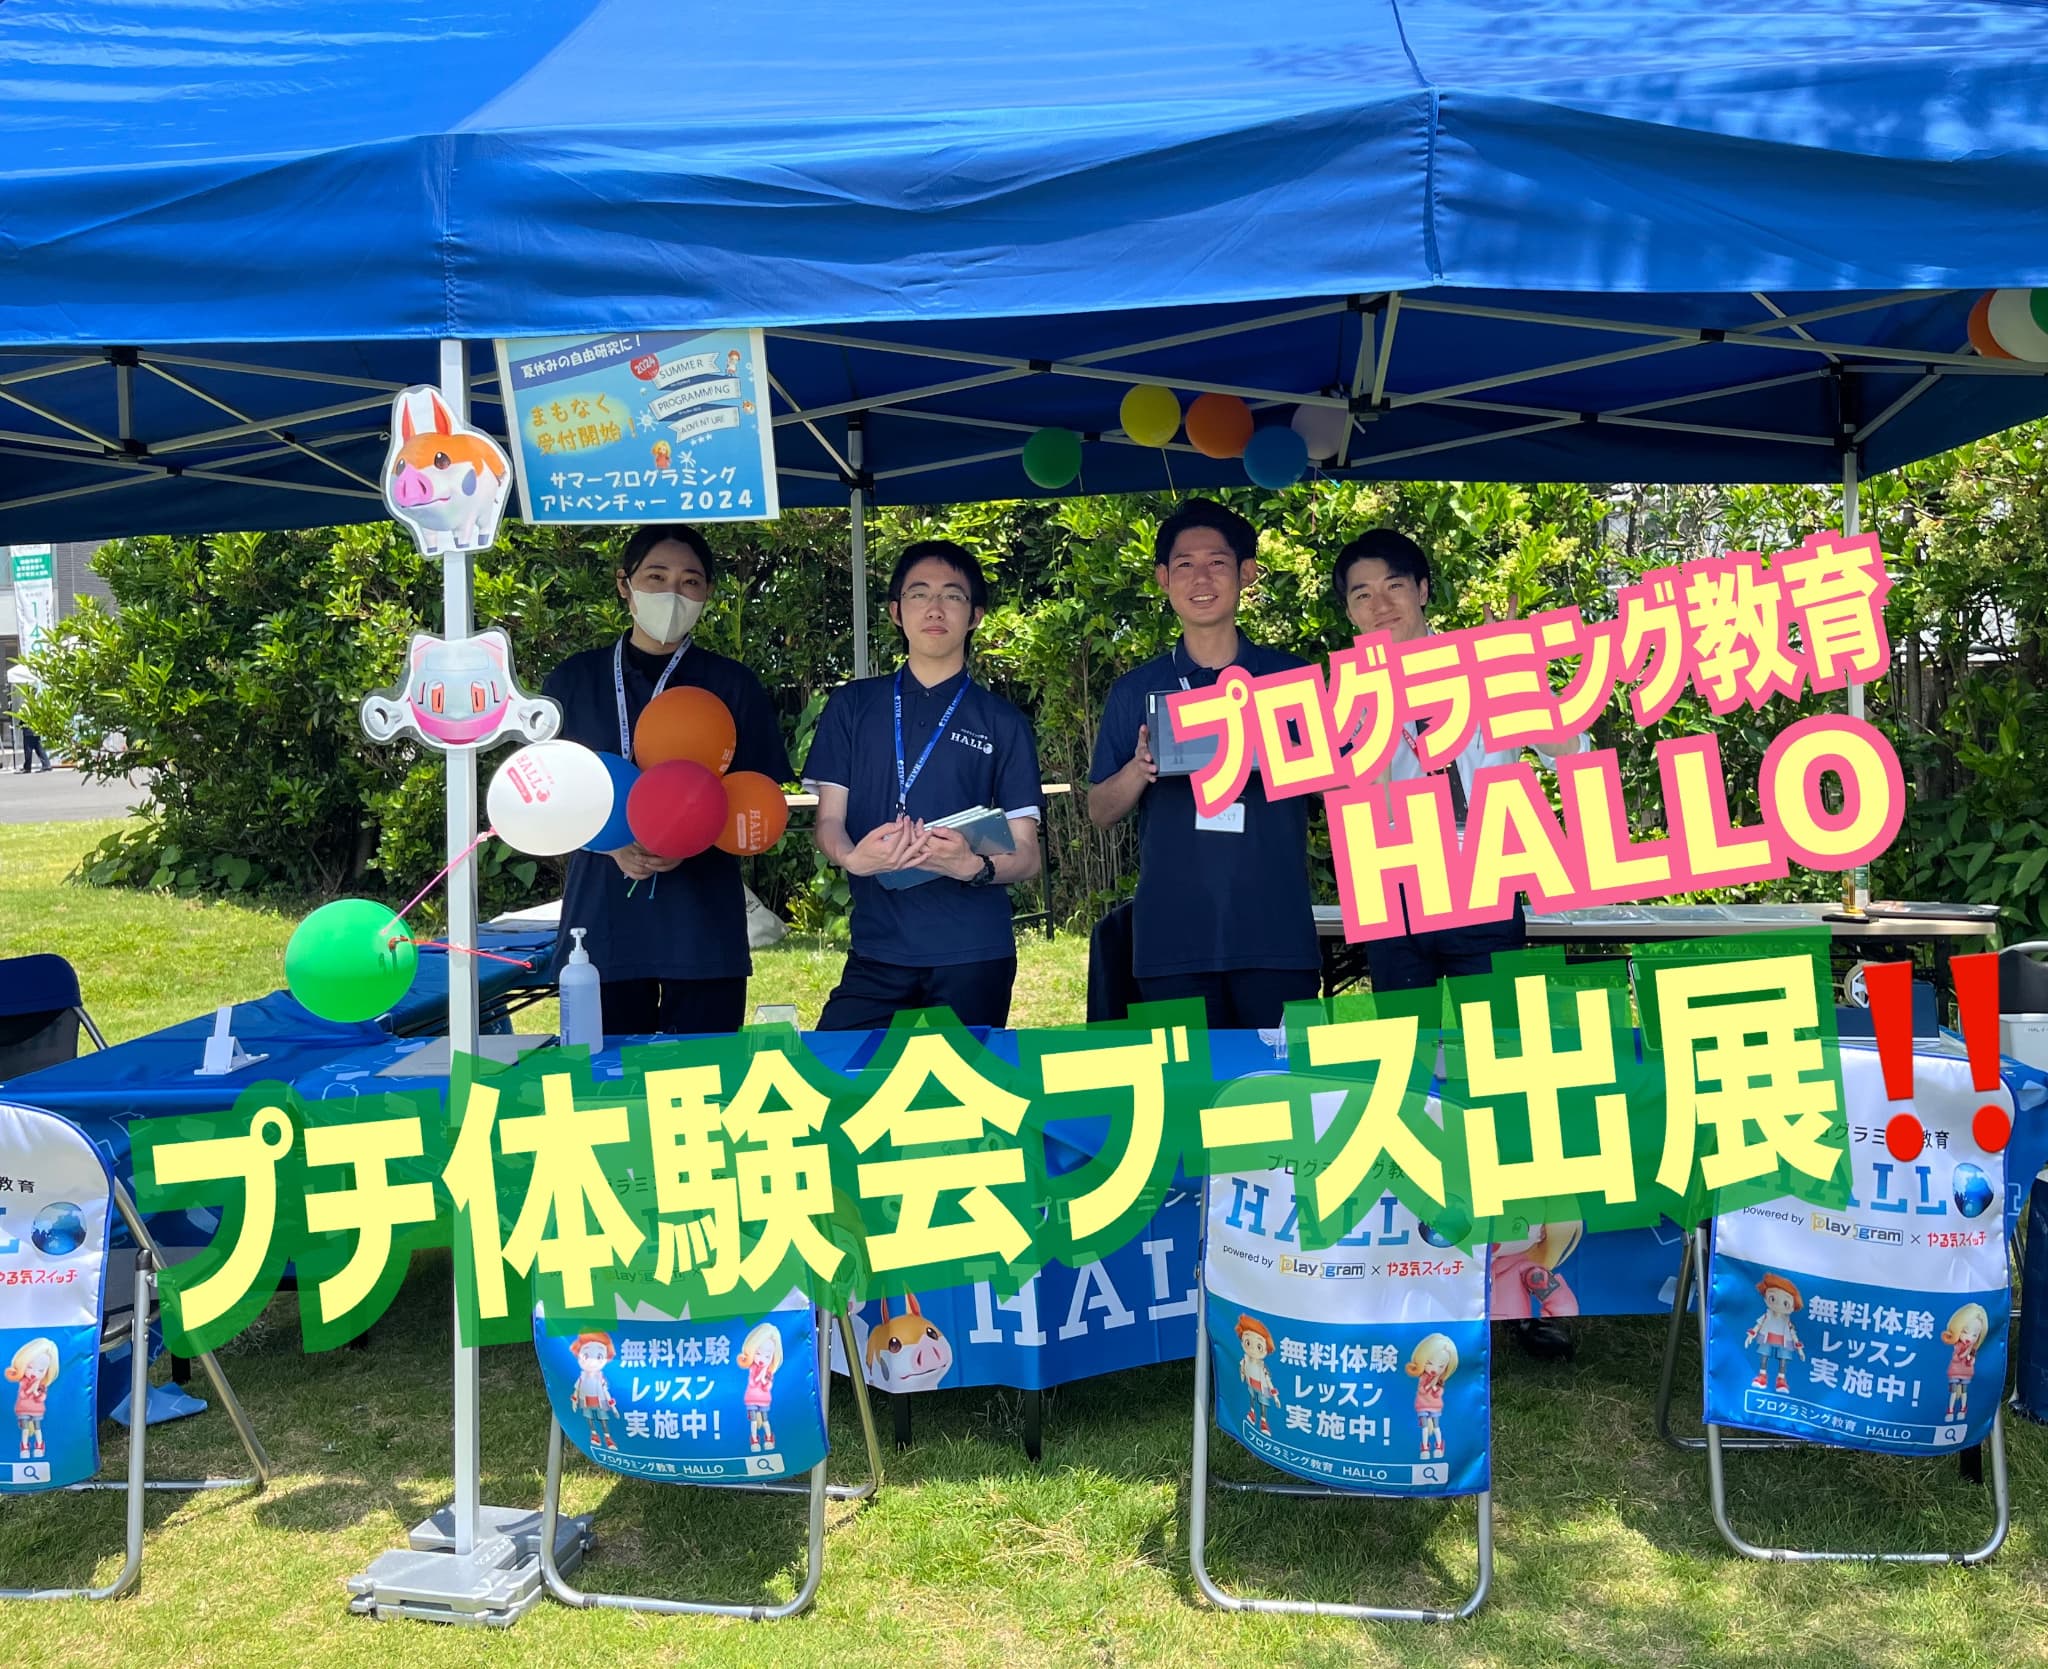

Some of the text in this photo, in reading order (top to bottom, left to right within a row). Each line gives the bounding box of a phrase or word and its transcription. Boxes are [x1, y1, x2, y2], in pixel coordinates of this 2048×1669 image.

[659, 359, 704, 379] SUMMER
[530, 393, 610, 428] まもなく
[657, 384, 730, 411] PROGRAMMING
[681, 415, 724, 433] ADVENTURE
[550, 466, 737, 489] サマープログラミング
[540, 489, 753, 512] アドベンチャー 2024
[1743, 1204, 1788, 1221] powered
[1790, 1214, 1804, 1226] by
[1927, 1231, 1987, 1248] やる気スイッチ
[1223, 1245, 1260, 1264] powered
[1261, 1255, 1273, 1269] by
[1386, 1260, 1465, 1277] やる気スイッチ
[1808, 1295, 1936, 1341] 無料体験
[620, 1335, 730, 1369] 無料体験
[1279, 1336, 1399, 1375] 無料体験
[1822, 1331, 1917, 1369] レッスン
[631, 1375, 715, 1403] レッスン
[1294, 1375, 1383, 1409] レッスン
[1755, 1397, 1912, 1440] プログラミング教育 HALLO
[600, 1453, 724, 1475] プログラミング教育 HALLO
[1248, 1431, 1388, 1482] プログラミング教育 HALLO
